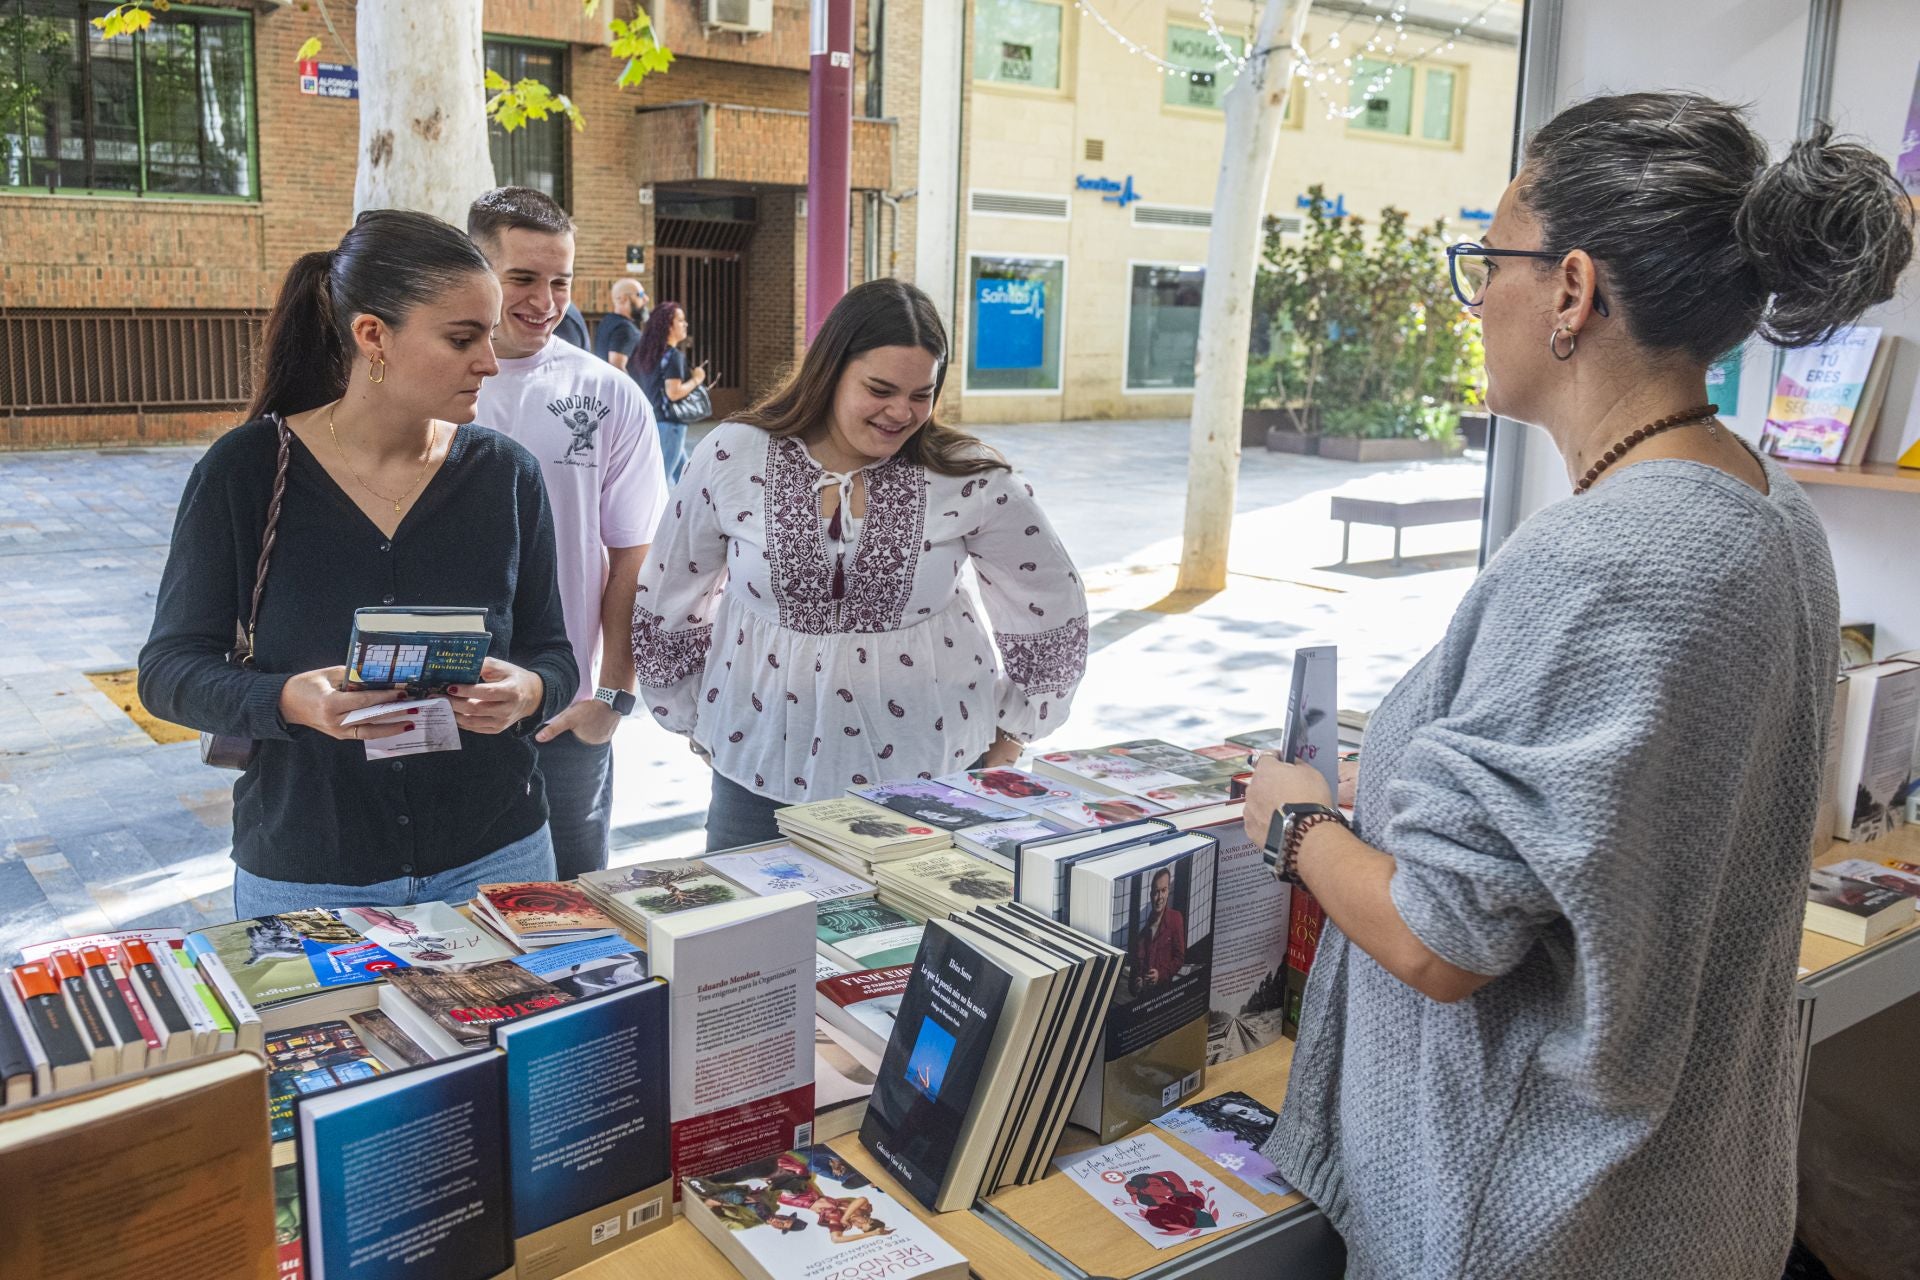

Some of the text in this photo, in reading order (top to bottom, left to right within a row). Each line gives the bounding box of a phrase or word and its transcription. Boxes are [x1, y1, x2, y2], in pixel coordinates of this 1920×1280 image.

[319, 77, 352, 89] ALFONSO
[319, 86, 351, 98] EL SABIO
[981, 285, 1030, 304] Sanitas
[1820, 350, 1838, 367] TÚ
[1806, 370, 1841, 383] ERES
[1786, 384, 1852, 402] TU LUGAR
[546, 394, 611, 421] HOODRICH
[1785, 399, 1841, 416] SEGURO
[1297, 910, 1318, 928] LOS
[839, 970, 882, 986] MOLA
[948, 958, 973, 982] Elvira Sastre
[697, 970, 761, 994] Eduardo Mendoza
[697, 993, 711, 1003] Tres
[712, 987, 737, 1000] enigmas
[738, 982, 752, 993] para
[752, 979, 758, 987] la
[758, 967, 797, 985] Organización
[920, 963, 928, 975] Lo
[926, 969, 936, 981] que
[938, 979, 953, 993] poesía
[951, 989, 961, 1000] aún
[960, 995, 967, 1004] no
[966, 996, 973, 1009] ha
[972, 1007, 988, 1020] escrito
[1122, 1165, 1151, 1176] EDICIÓN
[803, 1236, 913, 1279] TRES ENIGMAS PARA
[805, 1233, 900, 1271] LA ORGANIZACIÓN
